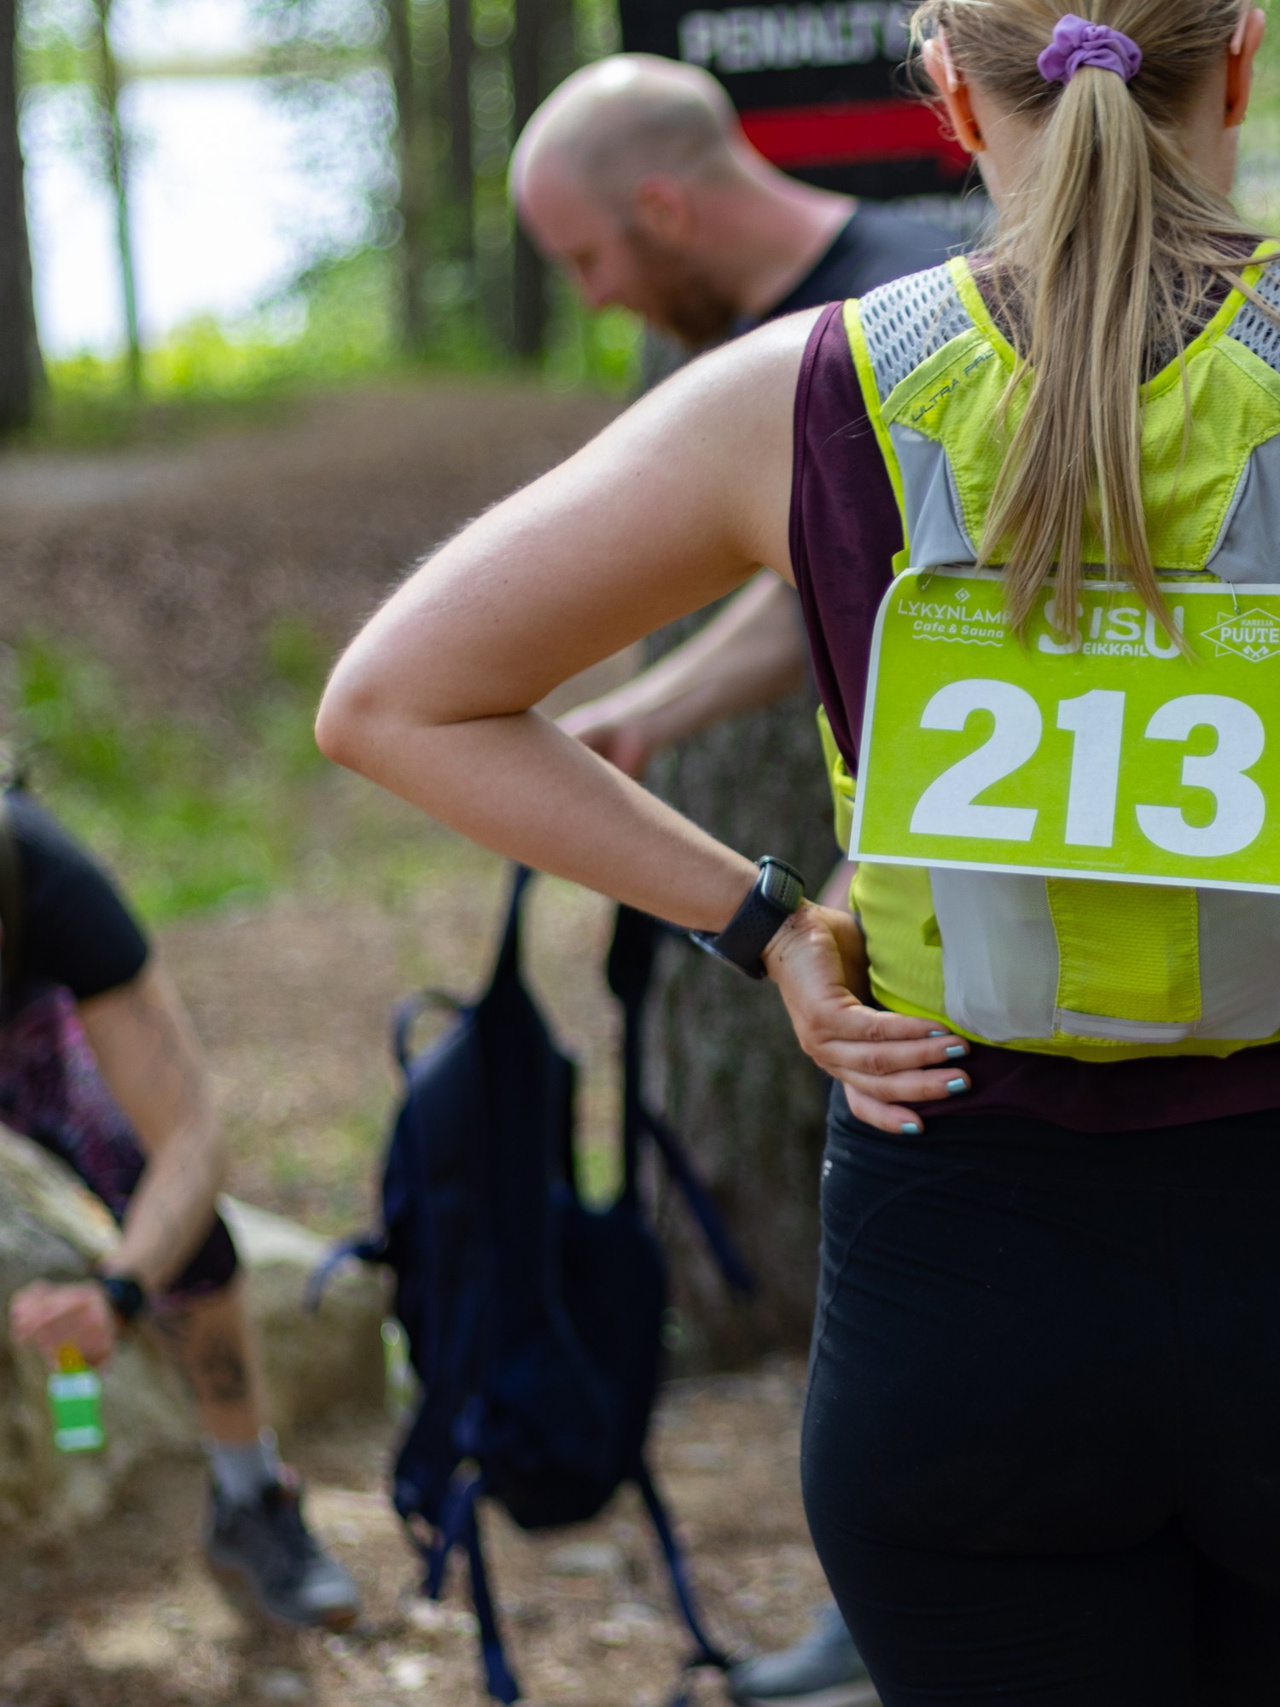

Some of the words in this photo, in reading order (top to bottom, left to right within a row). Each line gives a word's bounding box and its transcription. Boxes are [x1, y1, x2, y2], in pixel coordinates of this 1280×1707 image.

[911, 378, 959, 422] ULTRA
[912, 620, 946, 633] Cafe
[948, 624, 958, 634] &
[961, 625, 1005, 639] Sauna
[1037, 600, 1185, 660] SISU
[908, 677, 1266, 858] 213
